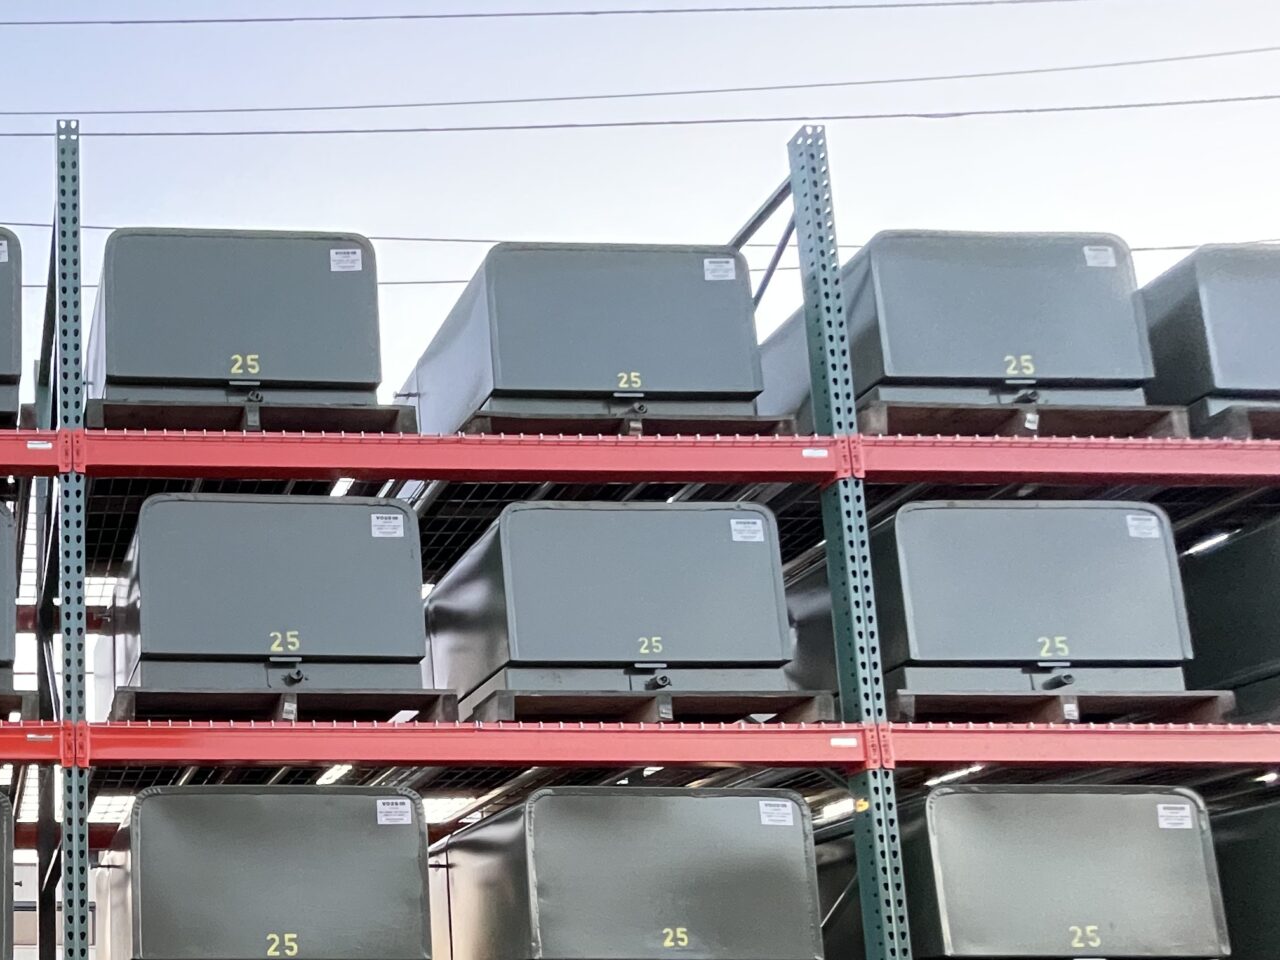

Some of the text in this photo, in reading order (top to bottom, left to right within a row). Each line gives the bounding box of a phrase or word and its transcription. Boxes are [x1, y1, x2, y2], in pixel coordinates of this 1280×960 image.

[230, 354, 259, 375] 25
[1007, 354, 1036, 376] 25
[617, 372, 641, 388] 25
[271, 632, 299, 653] 25
[639, 636, 663, 654] 25
[1040, 635, 1070, 657] 25
[268, 932, 298, 957] 25
[663, 928, 688, 948] 25
[1072, 925, 1100, 950] 25
